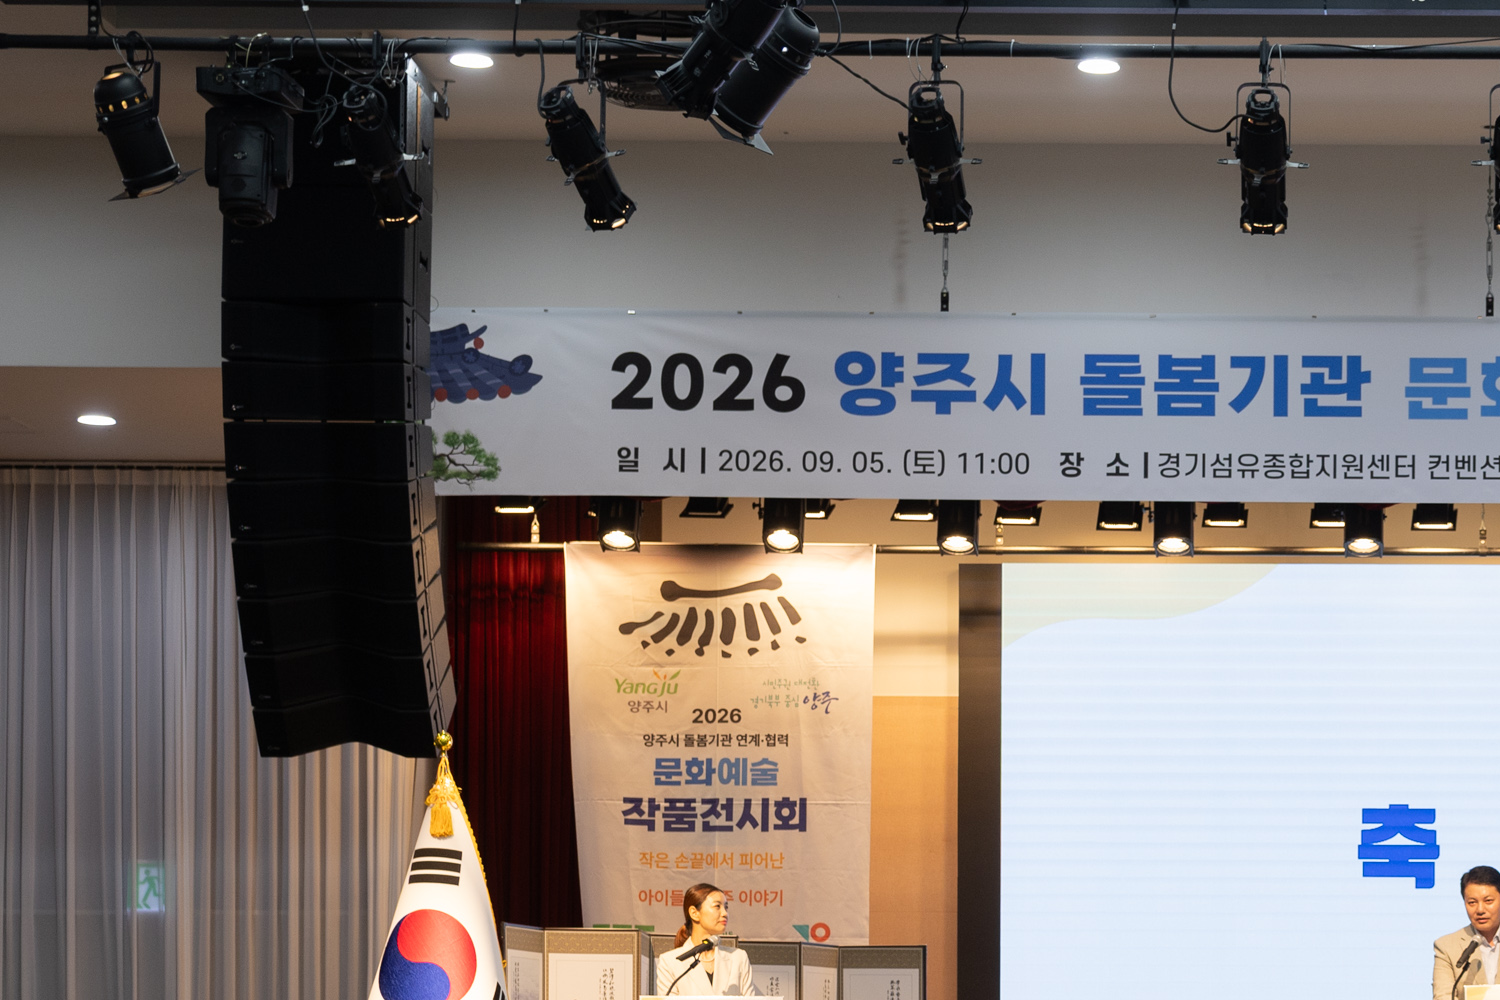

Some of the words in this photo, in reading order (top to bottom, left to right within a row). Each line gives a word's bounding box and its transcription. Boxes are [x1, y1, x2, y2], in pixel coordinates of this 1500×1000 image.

[611, 352, 806, 413] 2026
[834, 350, 1046, 417] 양주시
[1080, 354, 1371, 418] 돌봄기관
[617, 447, 641, 473] 일
[662, 447, 688, 473] 시
[718, 450, 792, 473] 2026.
[801, 450, 842, 474] 09.
[851, 450, 892, 474] 05.
[902, 448, 946, 477] (토)
[956, 452, 1030, 475] 11:00
[1059, 451, 1085, 478] 장
[1106, 454, 1131, 477] 소
[1157, 452, 1417, 481] 경기섬유종합지원센터
[628, 700, 668, 713] 양주시
[803, 691, 839, 714] 양주
[692, 708, 742, 724] 2026
[643, 733, 680, 747] 양주시
[683, 733, 732, 747] 돌봄기관
[736, 733, 789, 747] 연계·협력
[653, 757, 779, 787] 문화예술
[621, 796, 807, 832] 작품전시회
[1358, 804, 1440, 888] 축
[639, 852, 670, 868] 작은
[674, 852, 734, 869] 손끝에서
[739, 852, 785, 869] 피어난
[638, 889, 684, 906] 아이들
[739, 889, 784, 907] 이야기
